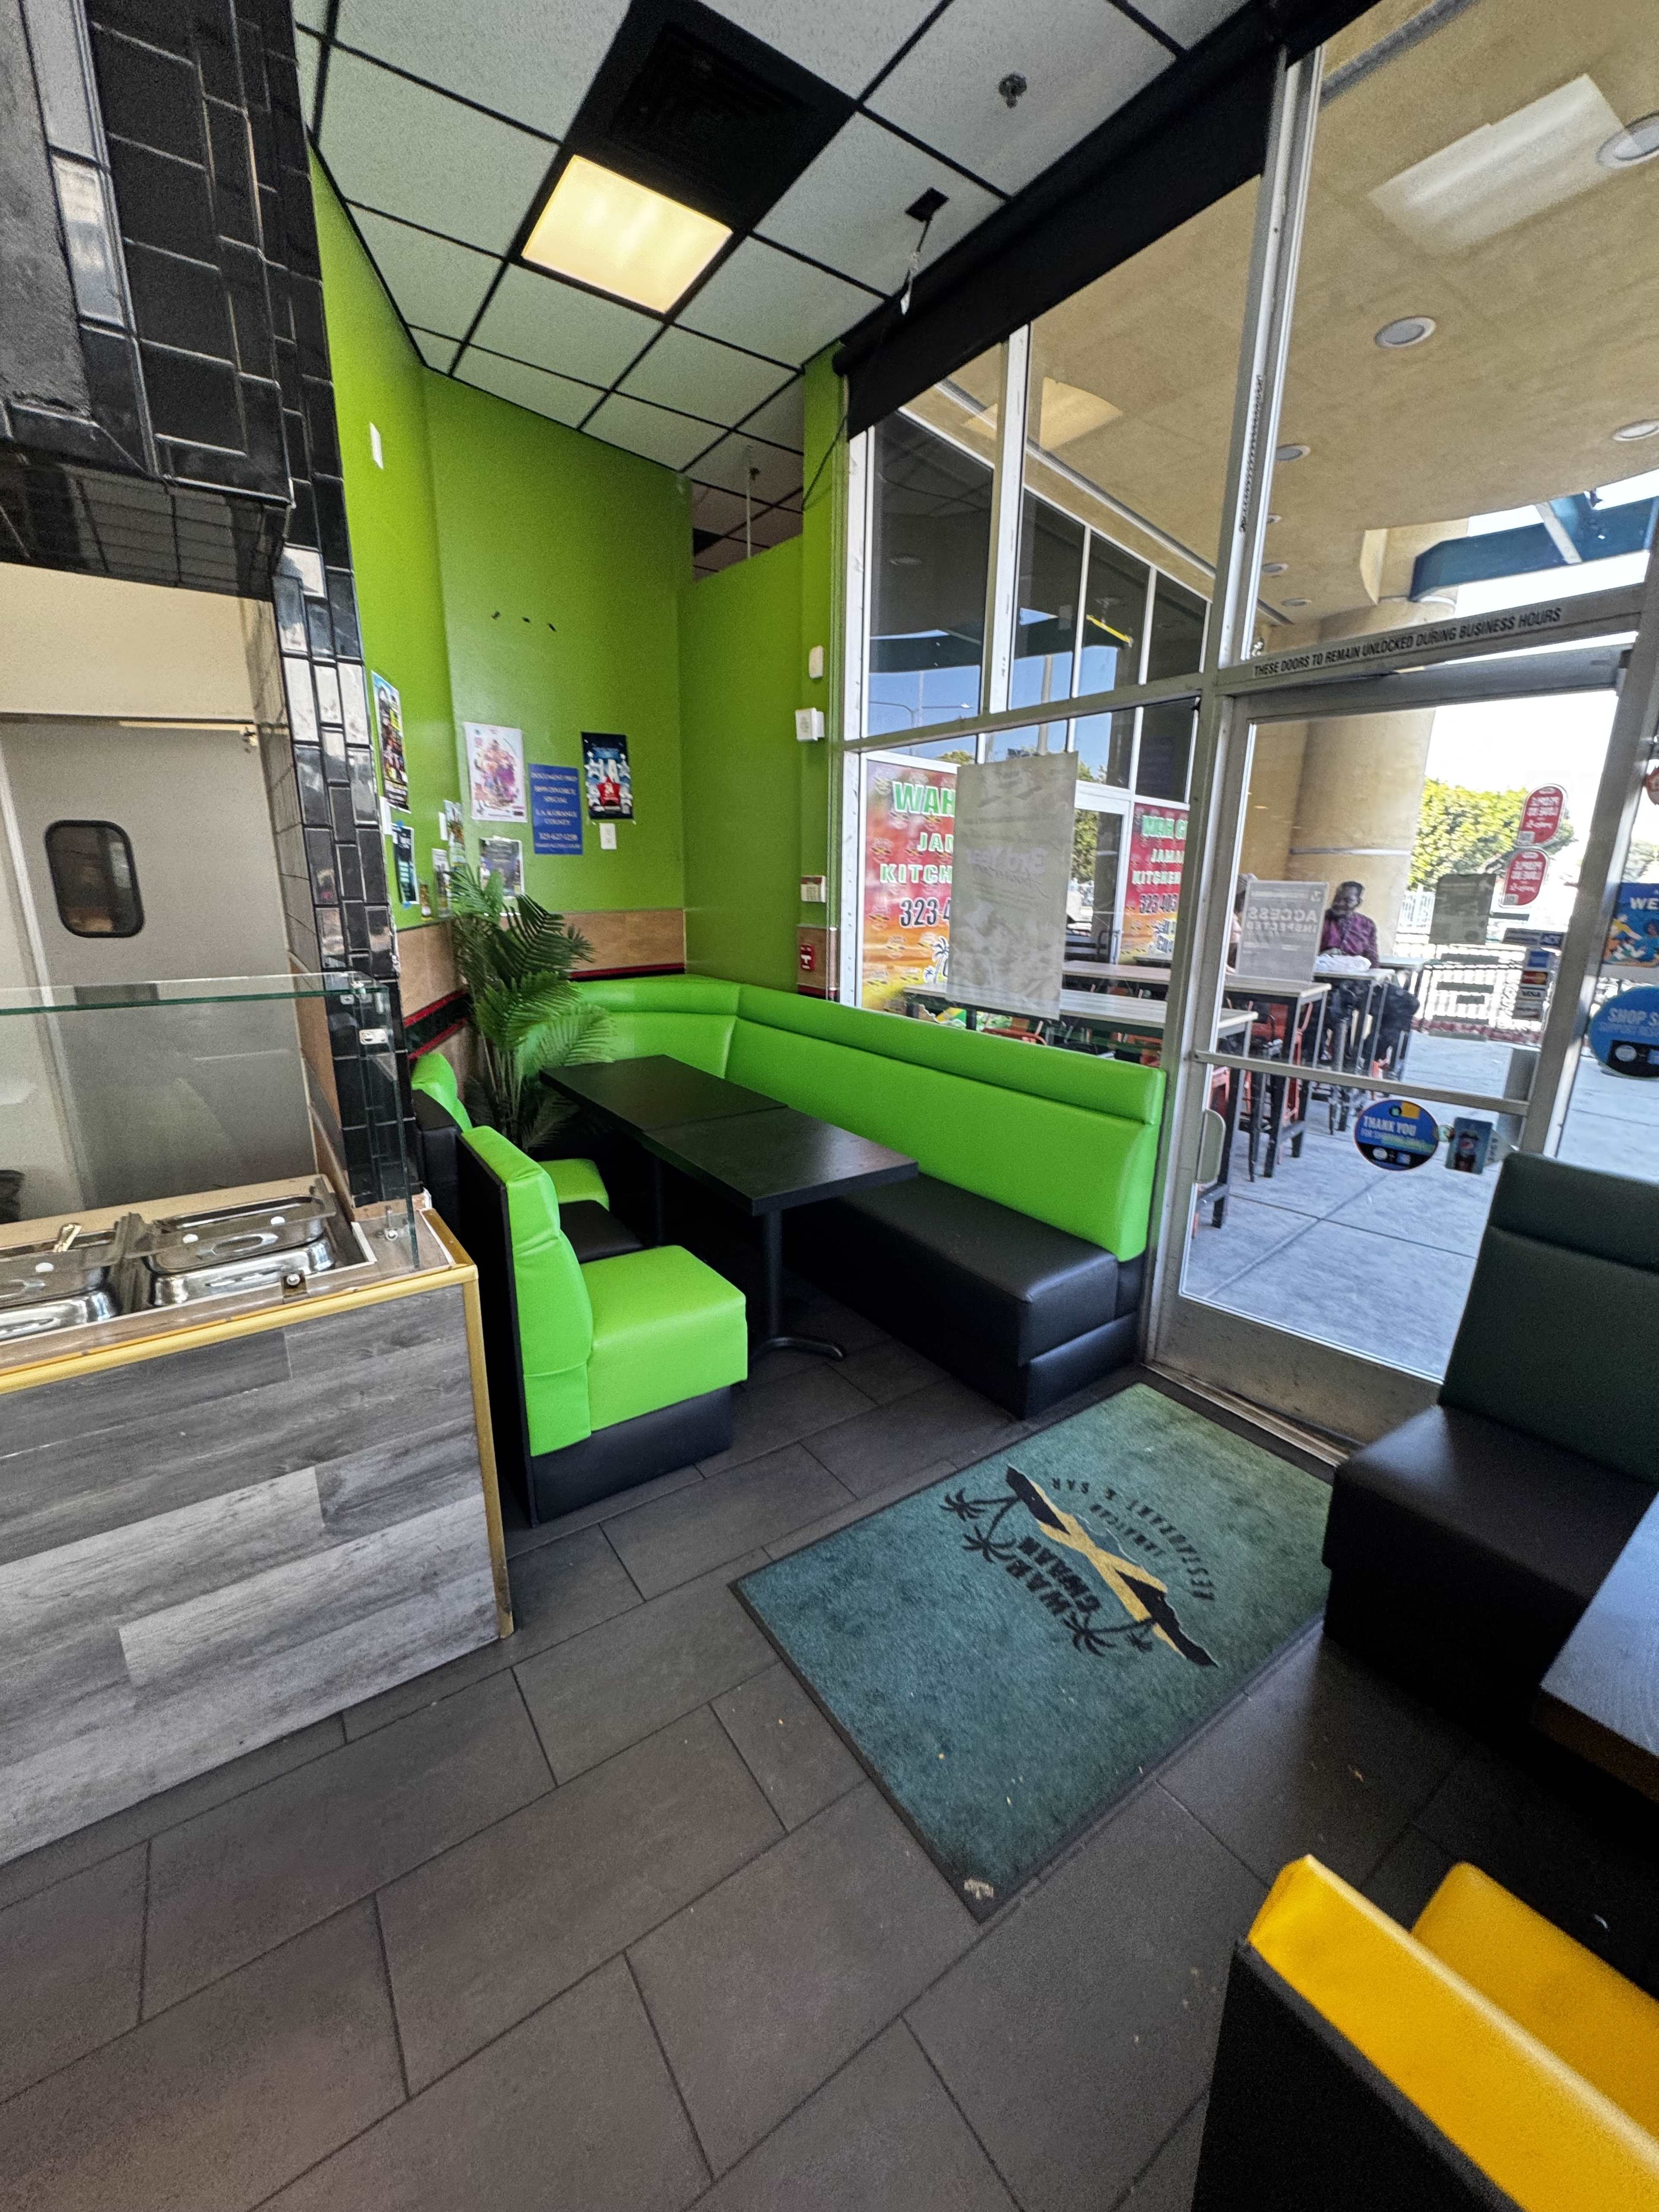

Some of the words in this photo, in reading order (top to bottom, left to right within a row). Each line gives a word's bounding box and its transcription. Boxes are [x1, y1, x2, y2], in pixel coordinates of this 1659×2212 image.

[1255, 662, 1279, 676] THESE
[1281, 656, 1310, 671] DOORS
[1312, 653, 1323, 666] TO
[1325, 646, 1360, 663] REMAIN
[1362, 636, 1414, 656] UNLOCKED
[1416, 627, 1457, 646] DURING
[1459, 616, 1516, 639] BUSINESS
[1518, 607, 1562, 627] HOURS
[892, 781, 956, 817] WAH
[1141, 815, 1175, 838] WAH
[1607, 1007, 1647, 1025] SHOP
[1363, 1116, 1395, 1132] THANK
[1397, 1122, 1417, 1137] YOU
